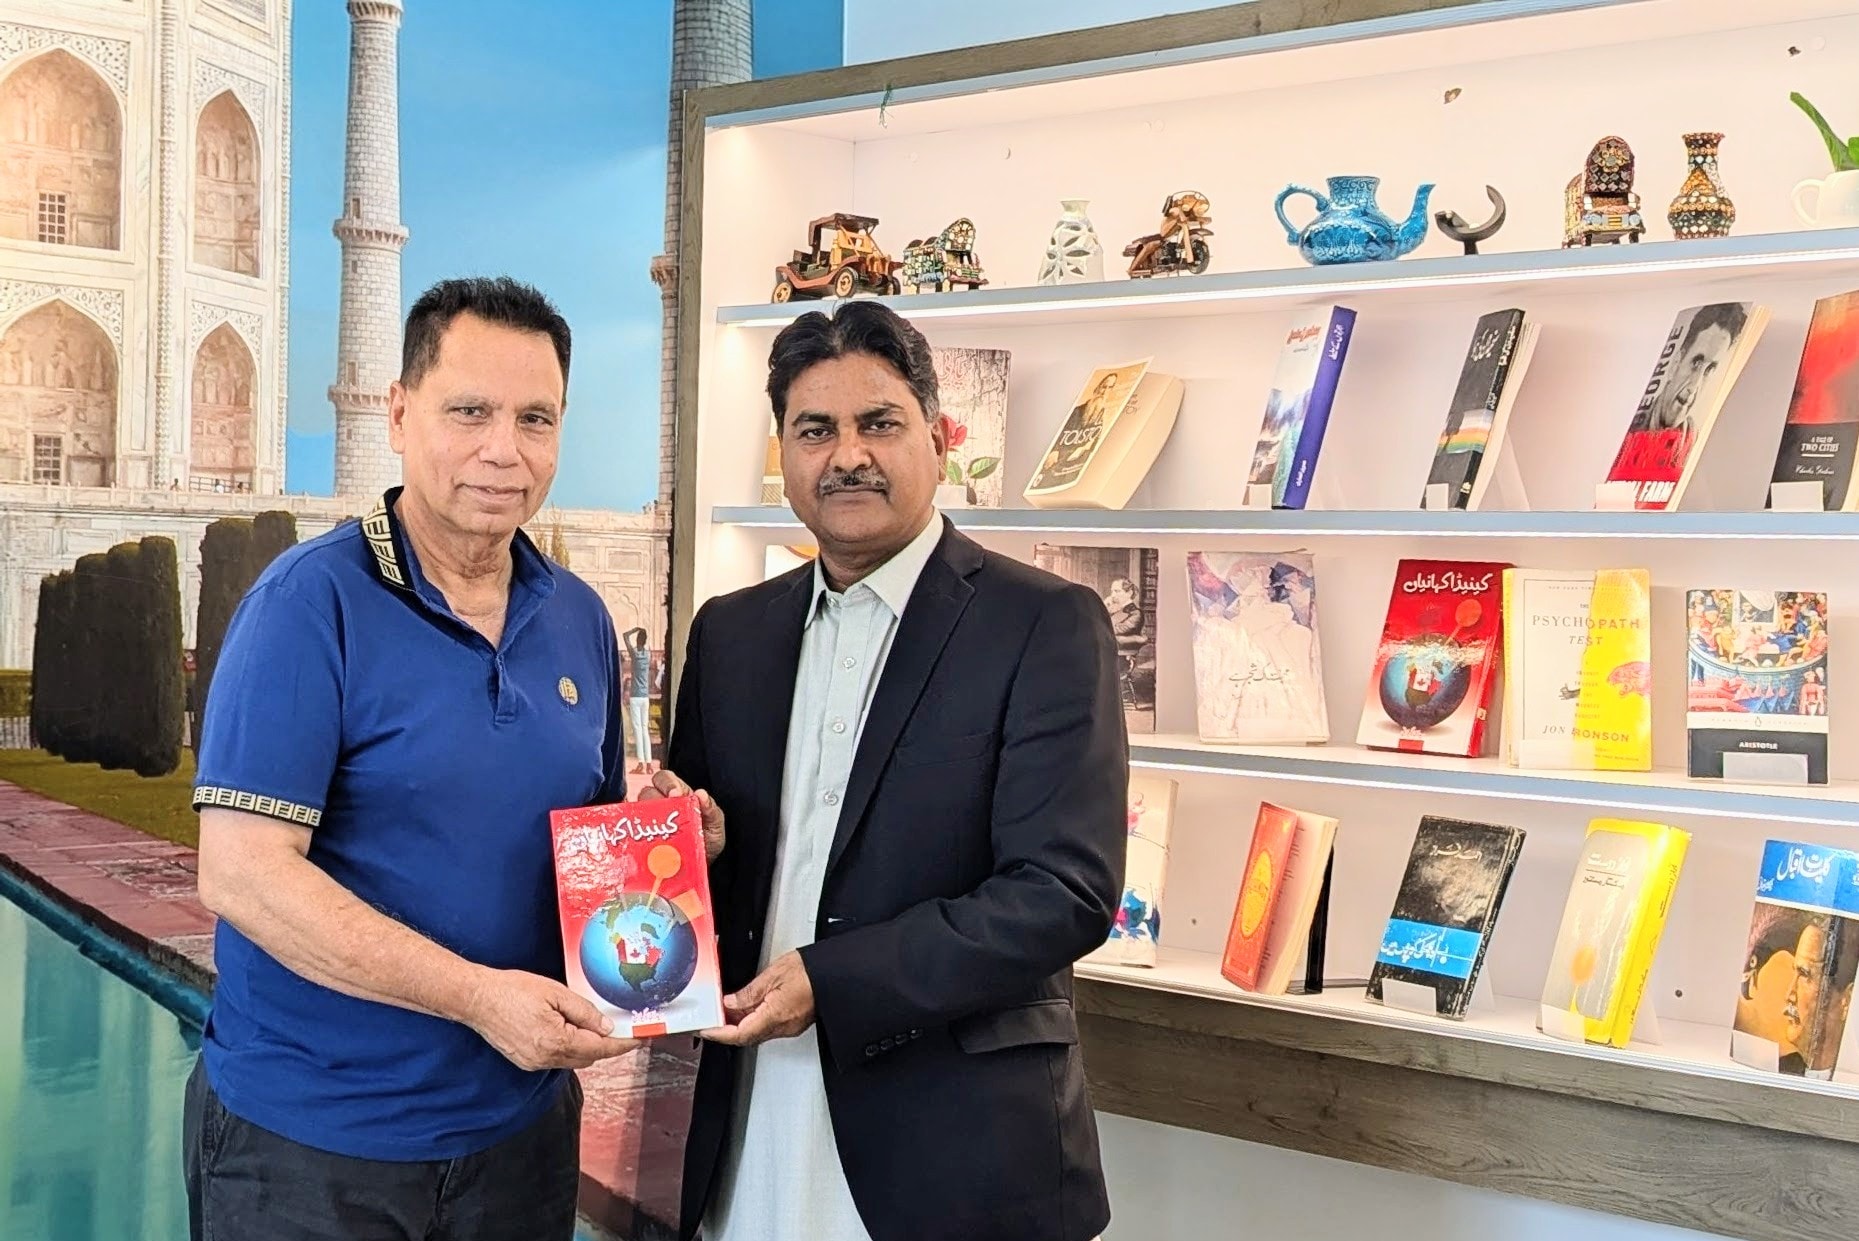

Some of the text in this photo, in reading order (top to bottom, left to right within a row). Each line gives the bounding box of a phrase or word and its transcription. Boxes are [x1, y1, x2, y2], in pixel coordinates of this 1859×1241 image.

[1630, 325, 1683, 429] GEORGE
[1060, 425, 1103, 446] TOLSTO
[1801, 443, 1839, 453] TWO CITIES
[1638, 481, 1676, 502] FARM
[1532, 615, 1640, 629] PSYCHOPATH
[1569, 635, 1603, 646] TEST
[1542, 725, 1629, 742] JON RONSON
[1739, 741, 1778, 750] ARISTOTLE
[627, 810, 680, 842] کینیڈا
[1776, 846, 1803, 881] اقبال
